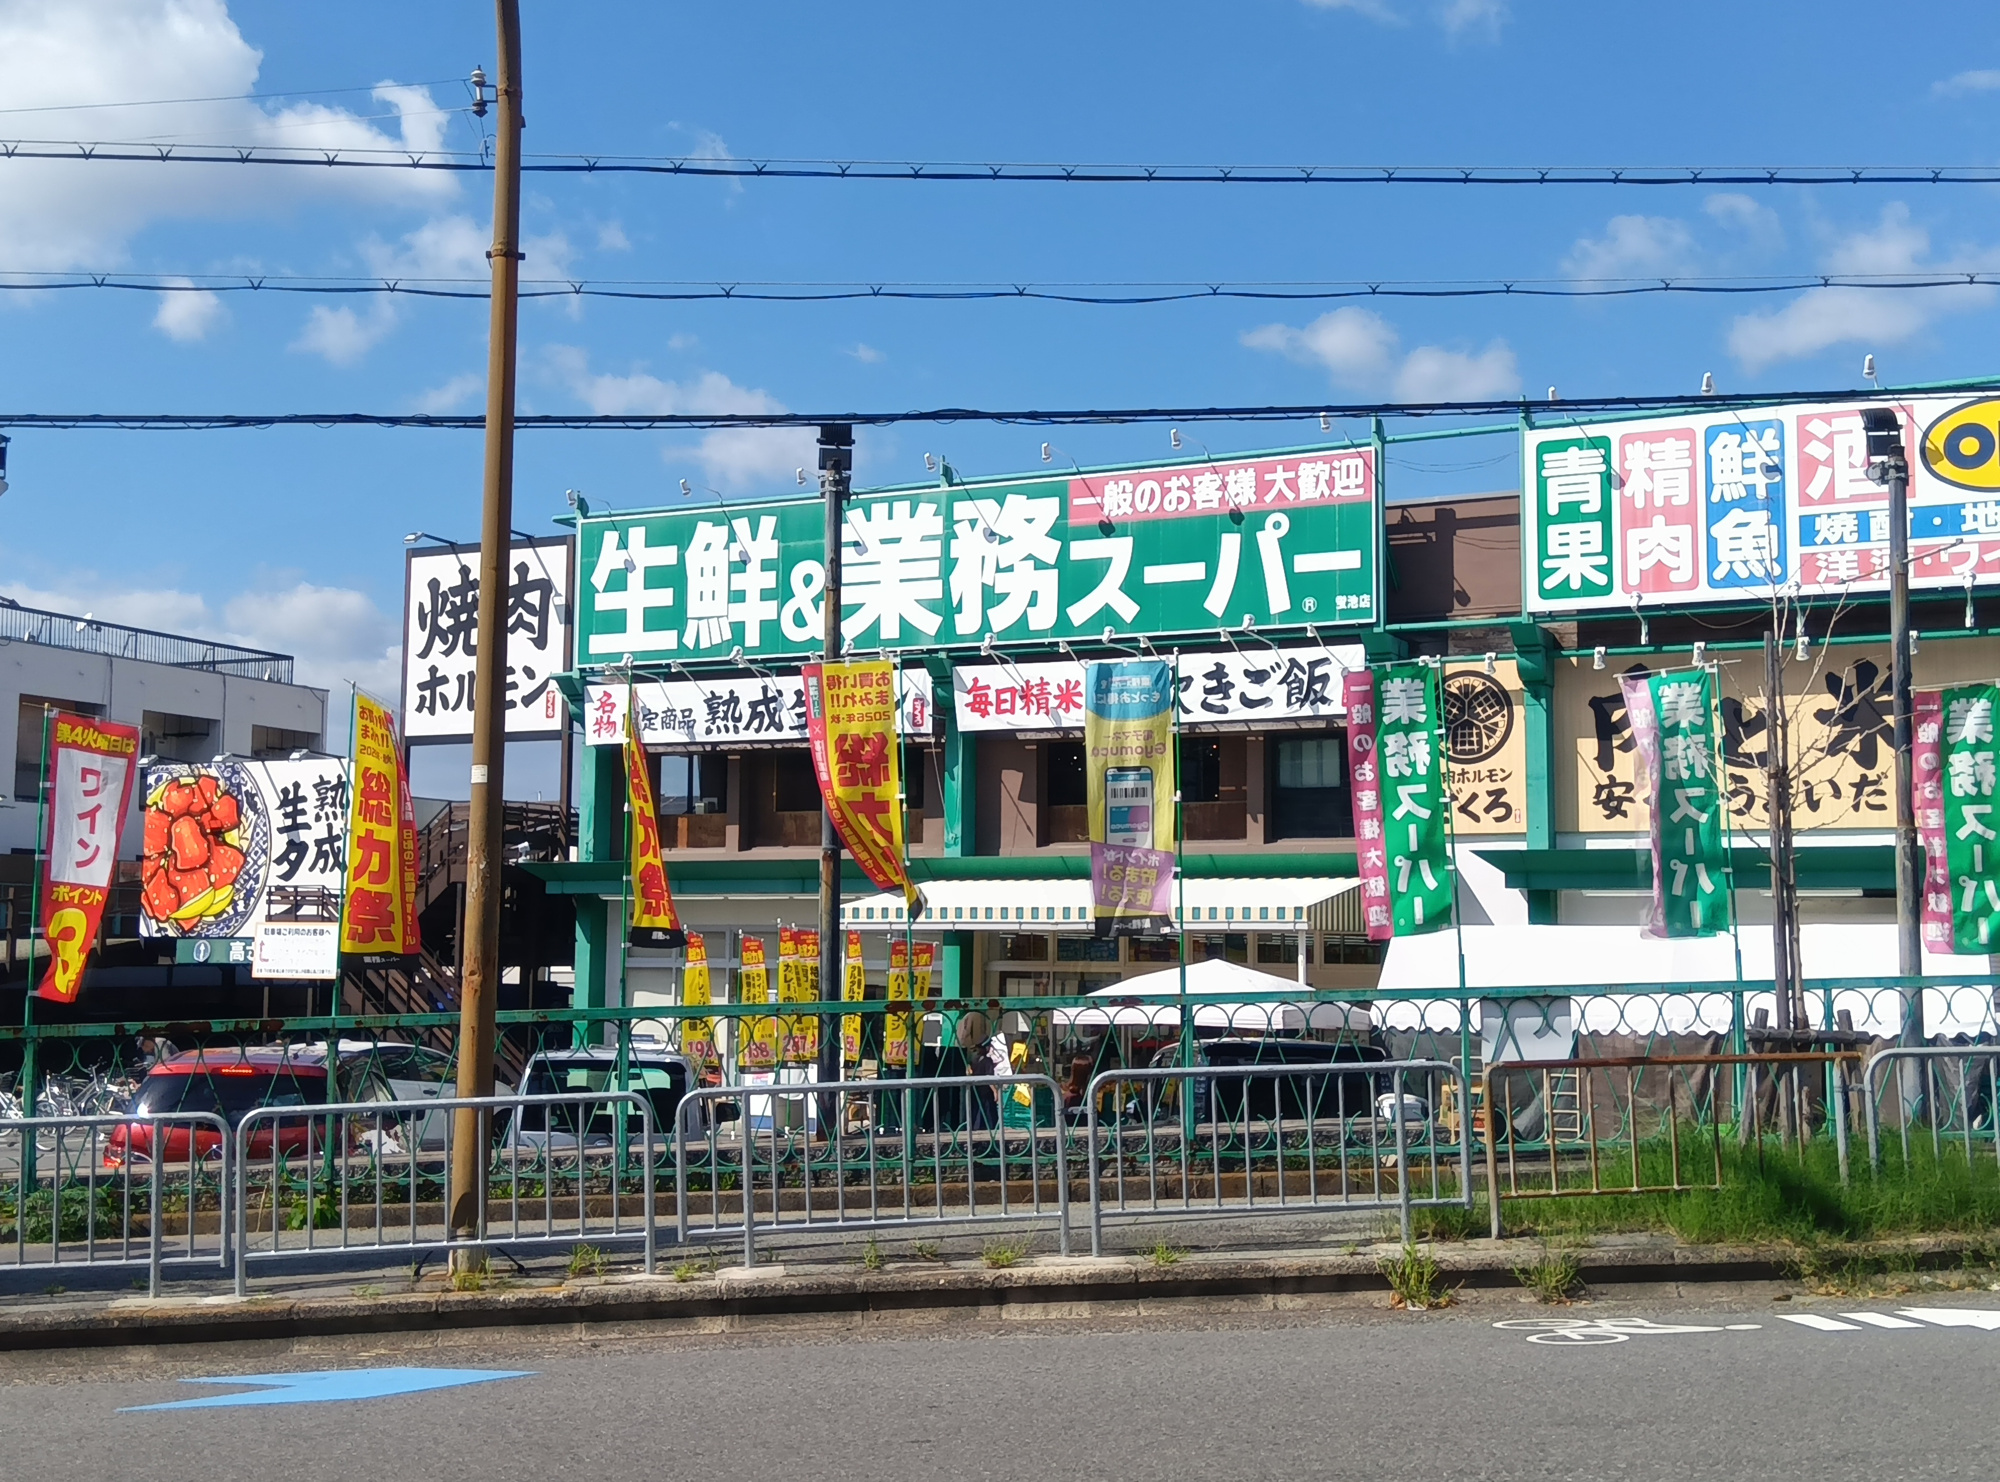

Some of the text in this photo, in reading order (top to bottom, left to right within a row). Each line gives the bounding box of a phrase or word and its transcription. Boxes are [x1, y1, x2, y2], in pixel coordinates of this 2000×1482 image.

[1073, 458, 1365, 516] 一般のお客様 大歓迎
[1943, 422, 2000, 470] O
[1541, 446, 1608, 590] 青果
[1623, 437, 1693, 586] 精肉
[1708, 428, 1781, 580] 鮮魚
[416, 561, 553, 659] 焼肉
[56, 722, 135, 754] 第4火曜日は
[592, 690, 617, 738] 名物
[966, 677, 1082, 718] 毎日精米
[75, 767, 102, 868] ワイン
[308, 773, 349, 875] 熟成
[347, 766, 396, 943] 総力祭
[51, 885, 103, 905] ポイント
